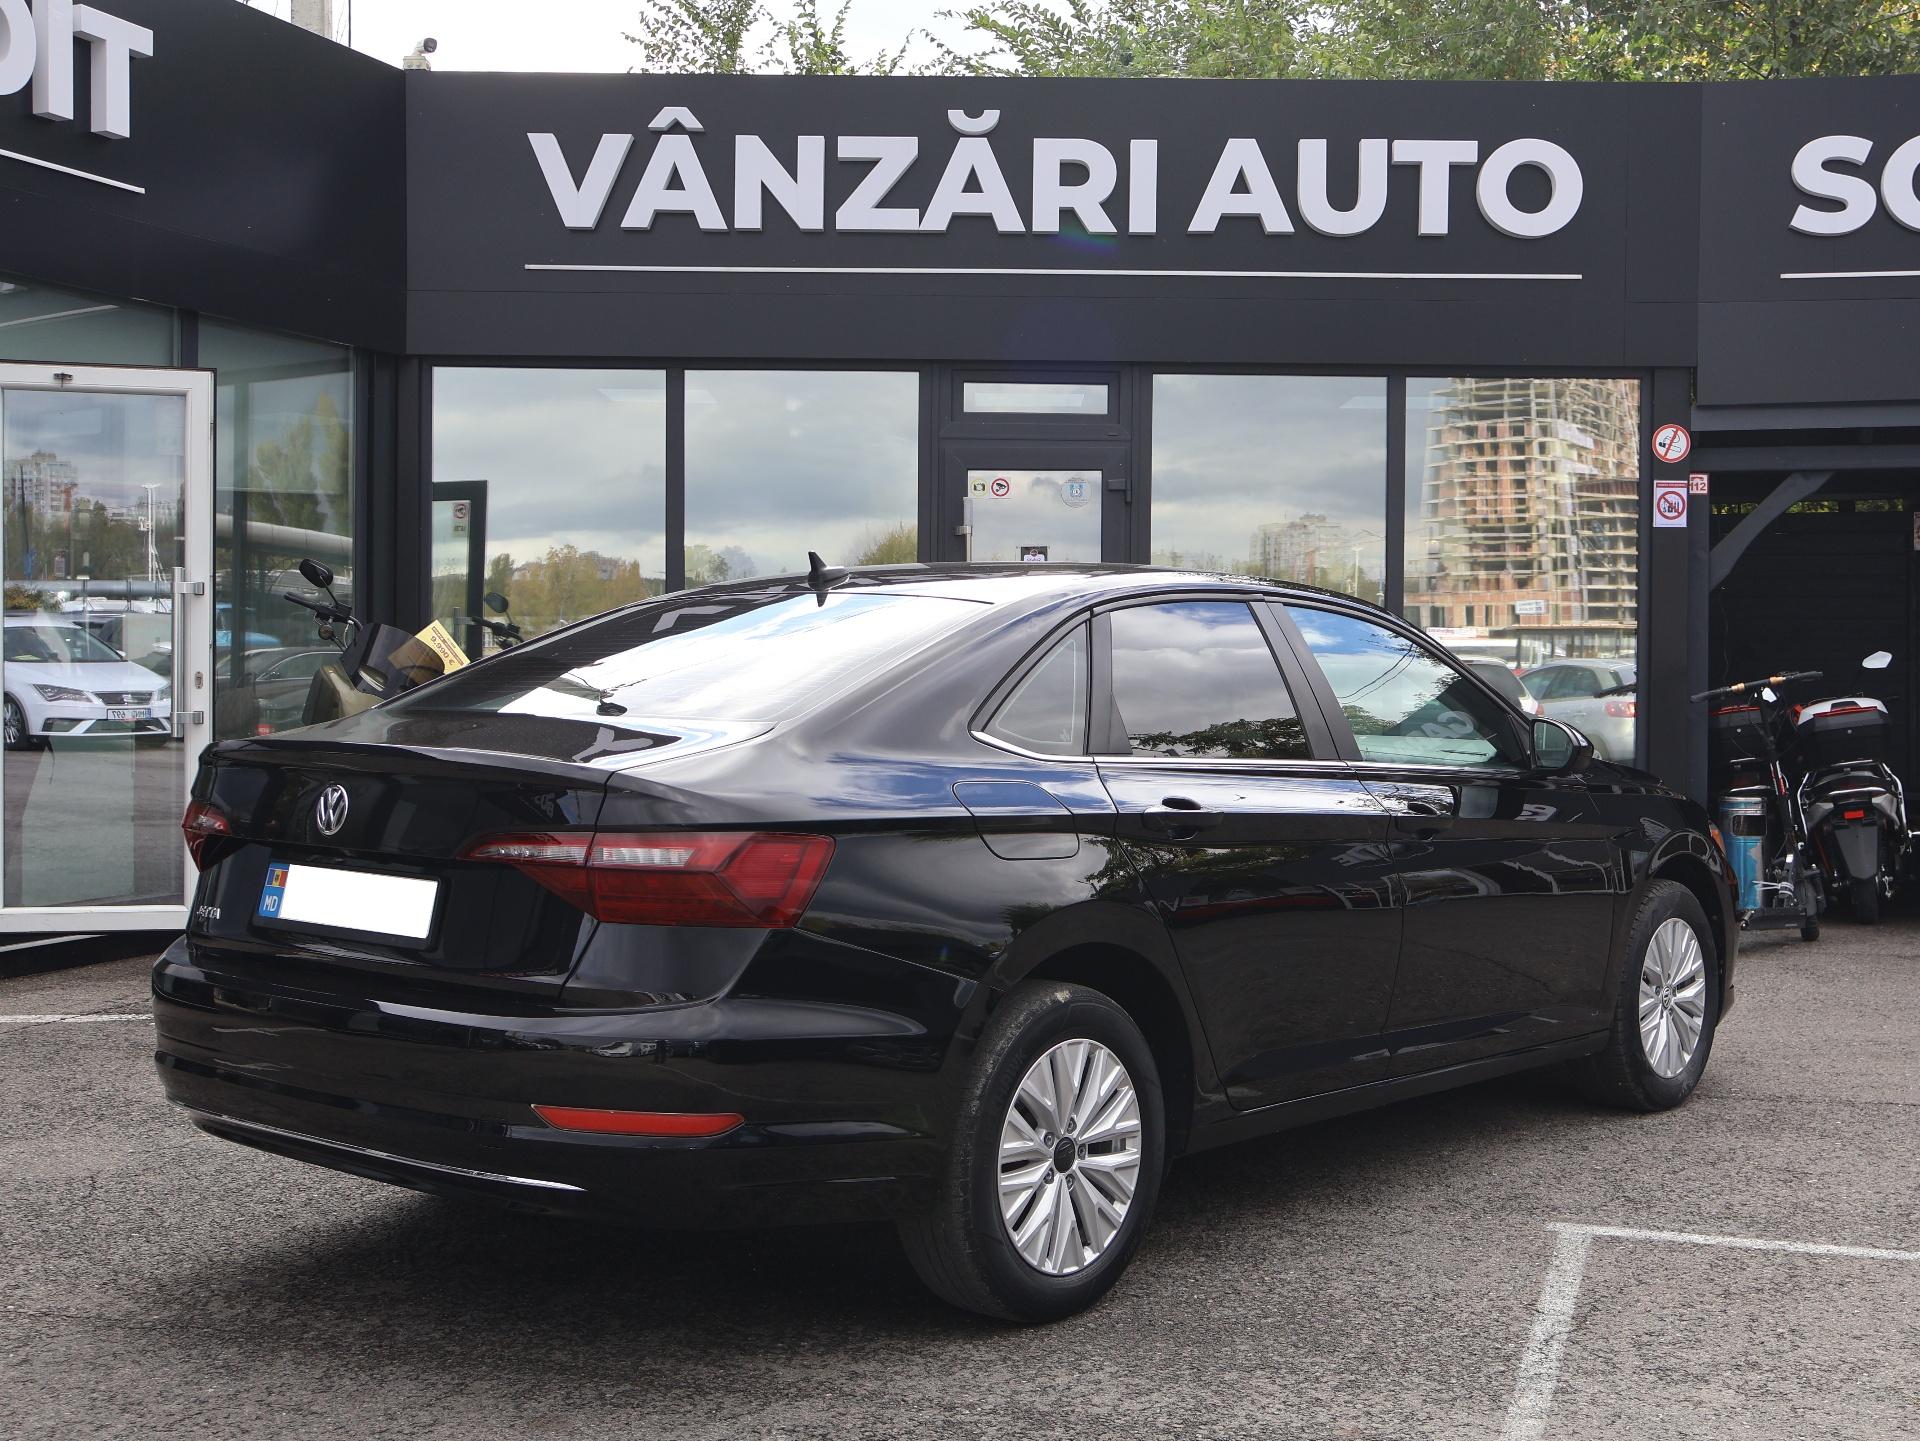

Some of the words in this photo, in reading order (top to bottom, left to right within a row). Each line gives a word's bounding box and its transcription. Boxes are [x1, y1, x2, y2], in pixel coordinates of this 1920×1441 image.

[527, 107, 1157, 235] VÂNZĂRI
[1188, 138, 1583, 237] AUTO
[1689, 482, 1706, 491] 112
[263, 895, 279, 912] MD
